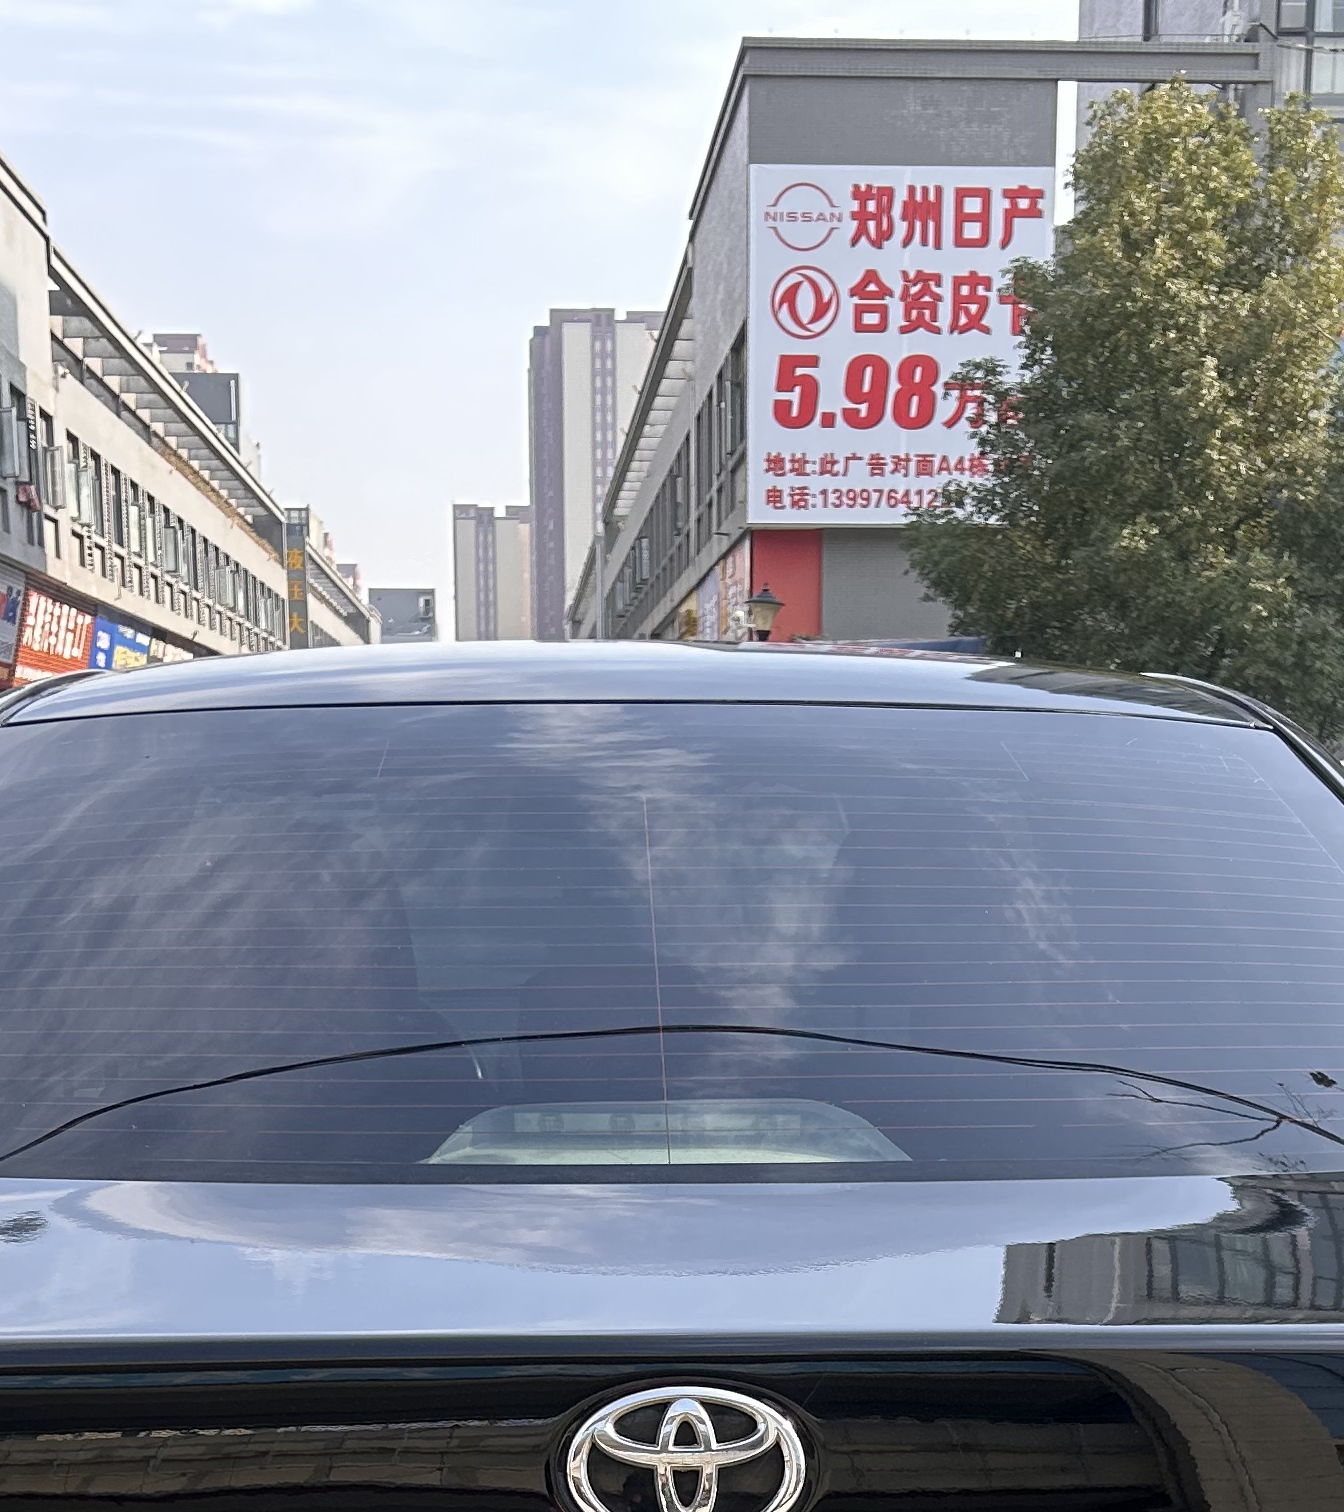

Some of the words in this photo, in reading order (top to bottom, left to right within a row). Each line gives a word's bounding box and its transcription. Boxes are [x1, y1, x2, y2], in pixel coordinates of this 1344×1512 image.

[763, 210, 844, 224] NISSAN
[849, 183, 1045, 250] 郑州日产
